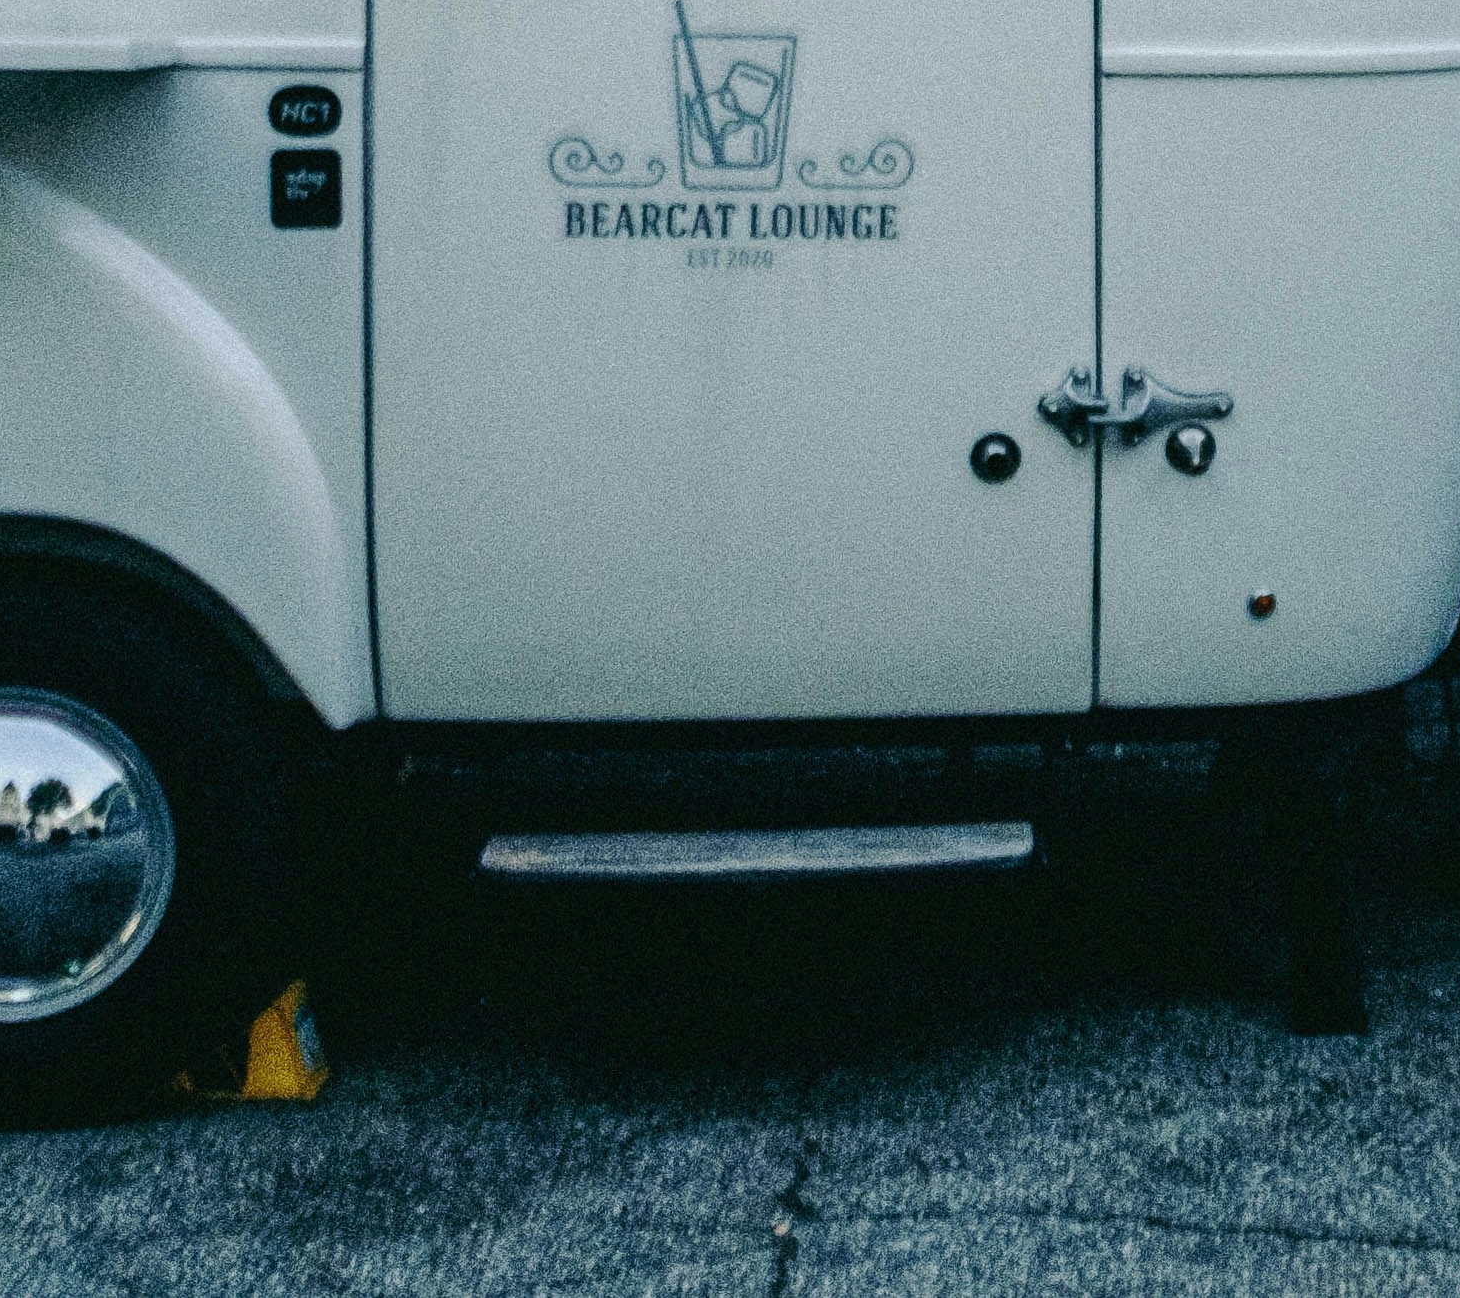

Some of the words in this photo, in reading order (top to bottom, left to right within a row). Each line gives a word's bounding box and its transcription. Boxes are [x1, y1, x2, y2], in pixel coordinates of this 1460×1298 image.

[281, 102, 330, 123] HC1
[564, 202, 736, 239] BEARCAT
[749, 203, 899, 240] LOUNGE
[686, 248, 721, 268] EST
